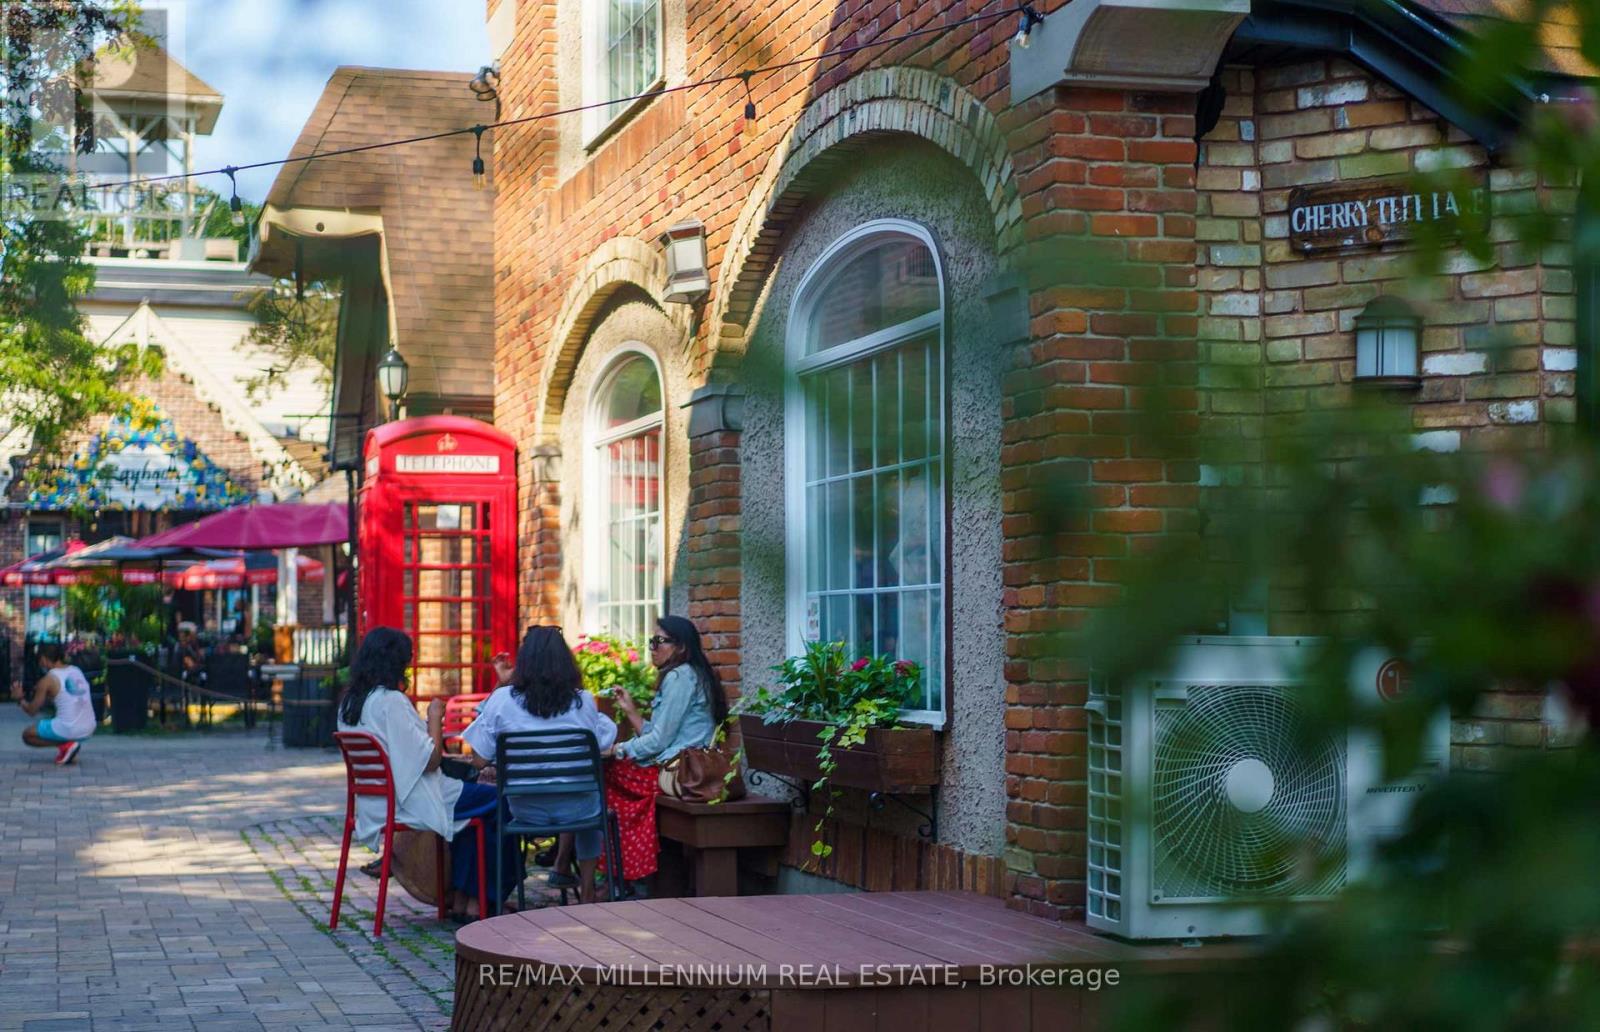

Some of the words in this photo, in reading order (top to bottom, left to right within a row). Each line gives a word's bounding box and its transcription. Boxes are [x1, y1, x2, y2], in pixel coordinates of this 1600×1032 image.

[1291, 199, 1371, 233] CHERRY
[1431, 187, 1485, 220] LAE
[402, 455, 493, 471] TELEPHONE
